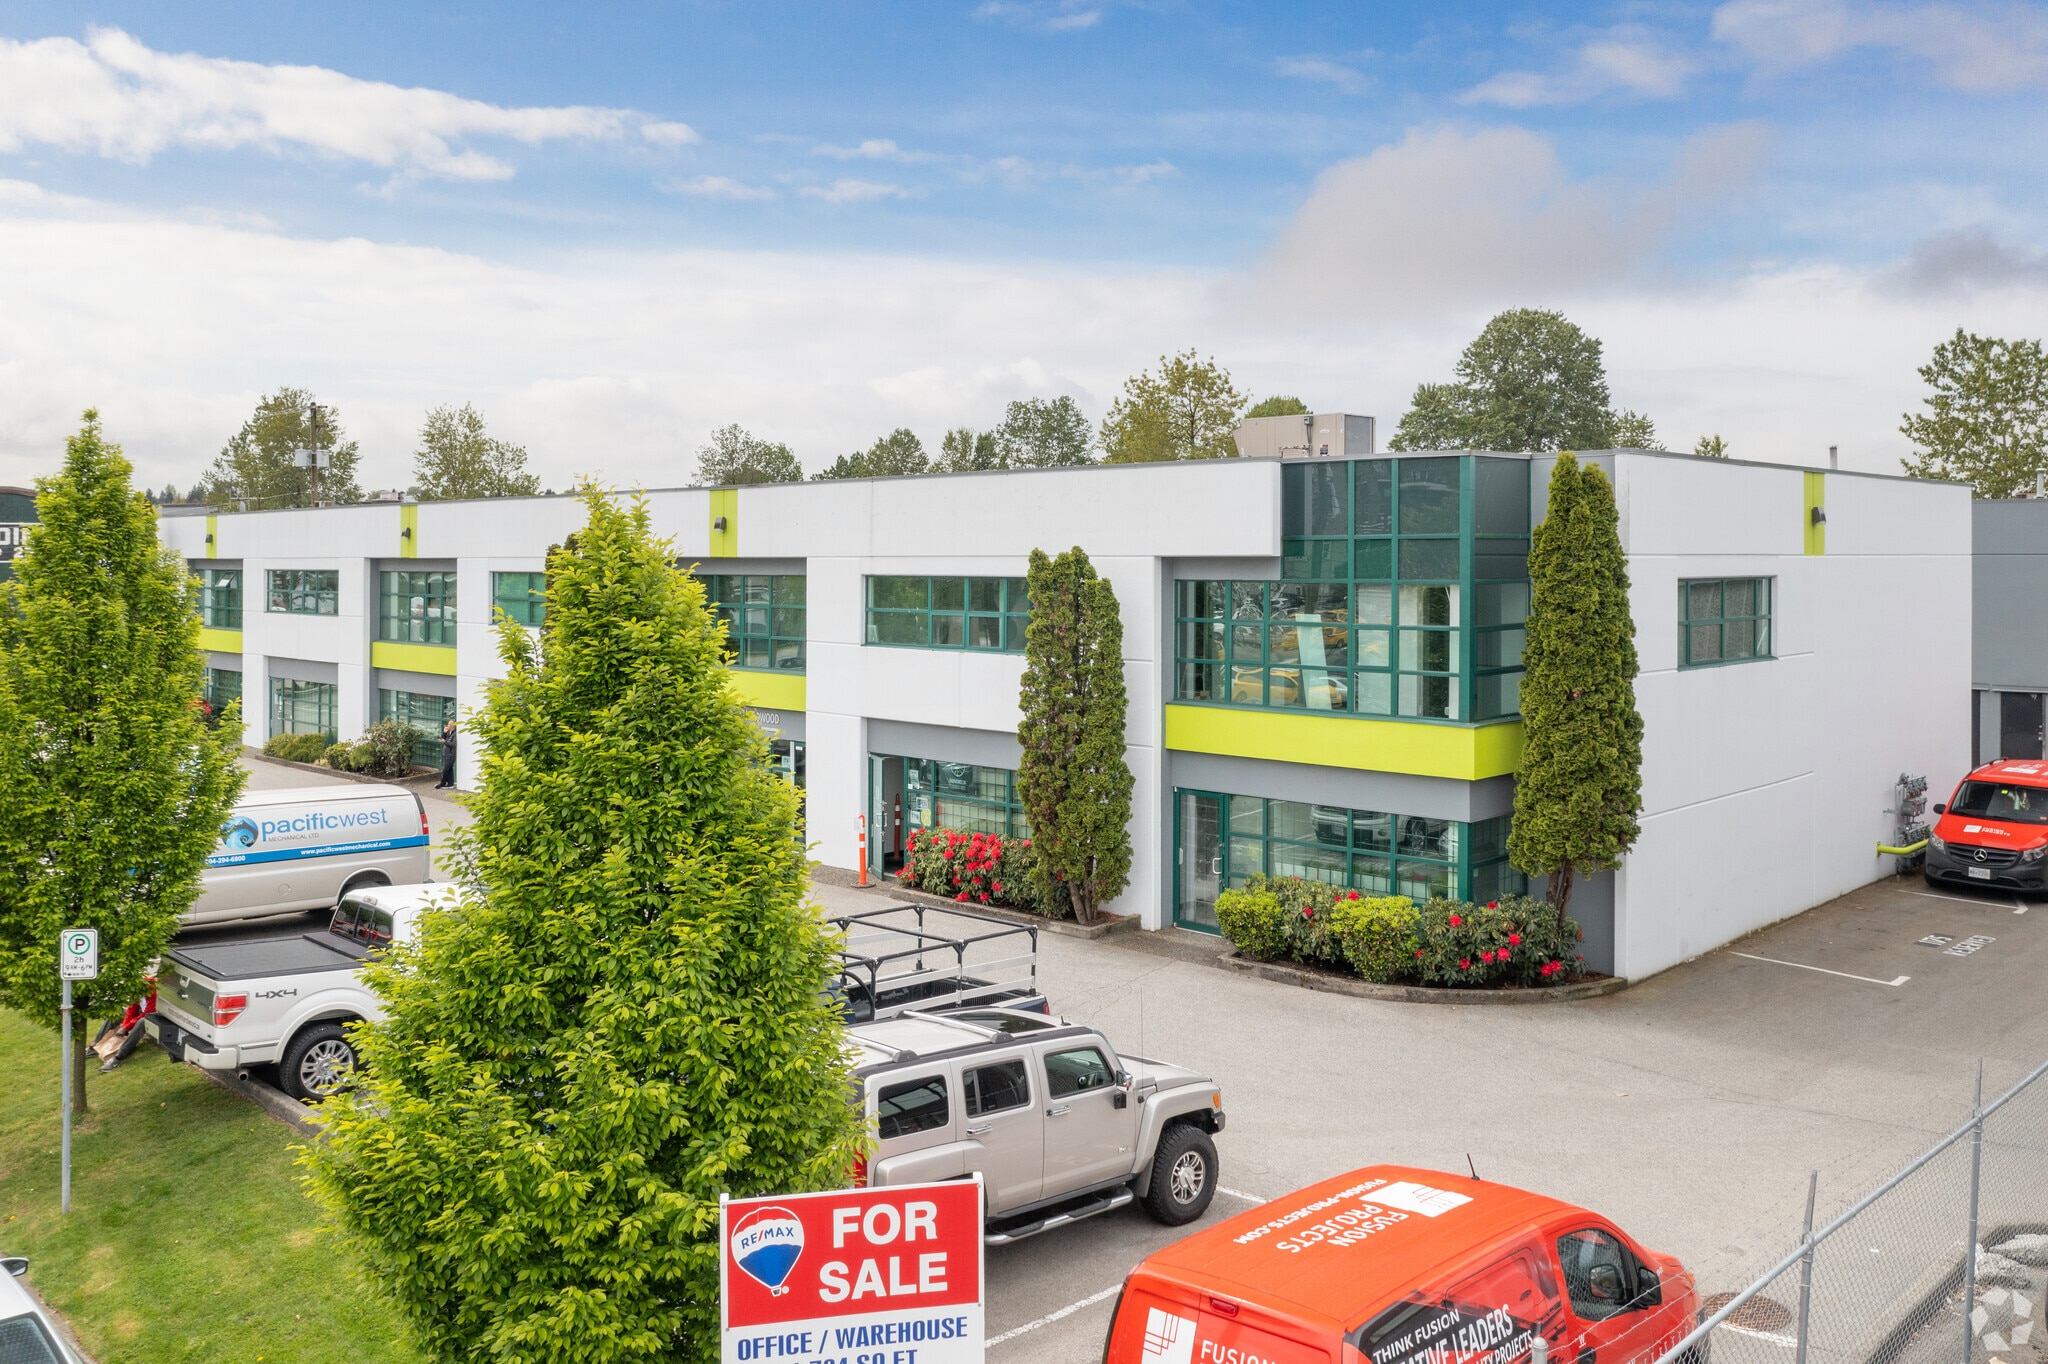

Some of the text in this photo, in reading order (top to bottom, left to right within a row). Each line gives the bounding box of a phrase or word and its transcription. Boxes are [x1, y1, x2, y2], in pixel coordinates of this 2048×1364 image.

[261, 808, 388, 842] pacificwest
[268, 834, 308, 842] MECHANICAL
[301, 841, 391, 855] www.pacificwestmechanical.com
[833, 1201, 938, 1248] FOR
[1233, 1178, 1388, 1245] FUSION-PROJECTS.COM
[1276, 1203, 1383, 1253] PROJECTS
[1327, 1210, 1409, 1247] FUSION
[741, 1227, 794, 1250] RE/MAX
[819, 1252, 948, 1303] SALE
[737, 1332, 812, 1361] OFFICE
[836, 1316, 968, 1350] WAREHOUSE
[1201, 1340, 1276, 1364] FUSI
[1373, 1308, 1460, 1364] THINK FUSION
[1452, 1304, 1513, 1362] LEADERS
[1495, 1329, 1532, 1364] PROJECTS
